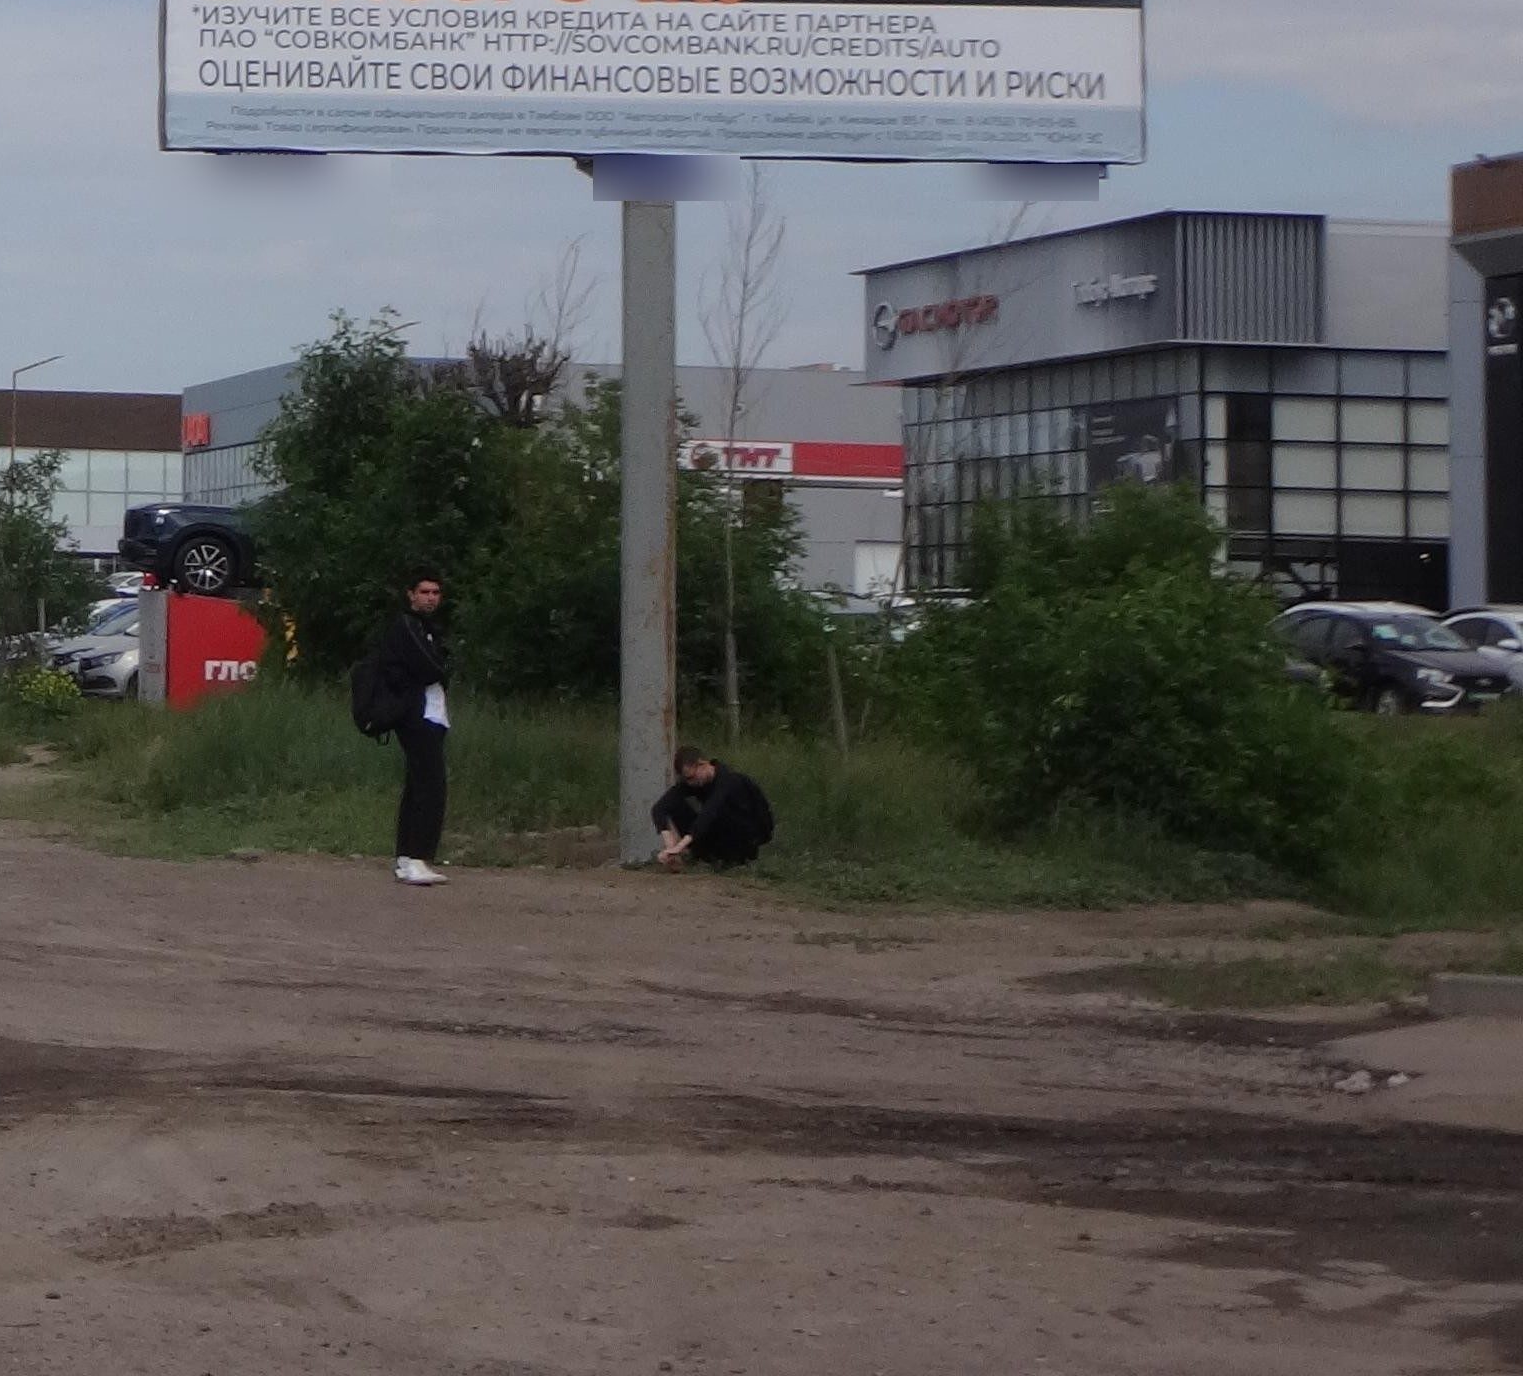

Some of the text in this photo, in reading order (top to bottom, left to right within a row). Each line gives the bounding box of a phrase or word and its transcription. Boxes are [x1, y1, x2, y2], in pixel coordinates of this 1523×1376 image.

[331, 7, 381, 27] ВСЕ
[388, 9, 516, 29] УСЛОВИЯ
[527, 11, 645, 33] КРЕДИТА
[657, 12, 694, 32] НА
[701, 9, 787, 33] САЙТЕ
[795, 13, 938, 34] ПАРТНЕРА
[199, 29, 256, 49] ПАО
[484, 31, 1001, 60] HTTP://SOVCOMBANK.RU/CREDITS/AUTO
[199, 56, 1106, 100] ОЦЕНИВАЙТЕ СВОИ ФИНАНСОВЫЕ ВОЗМОЖНОСТИ И РИСКИ
